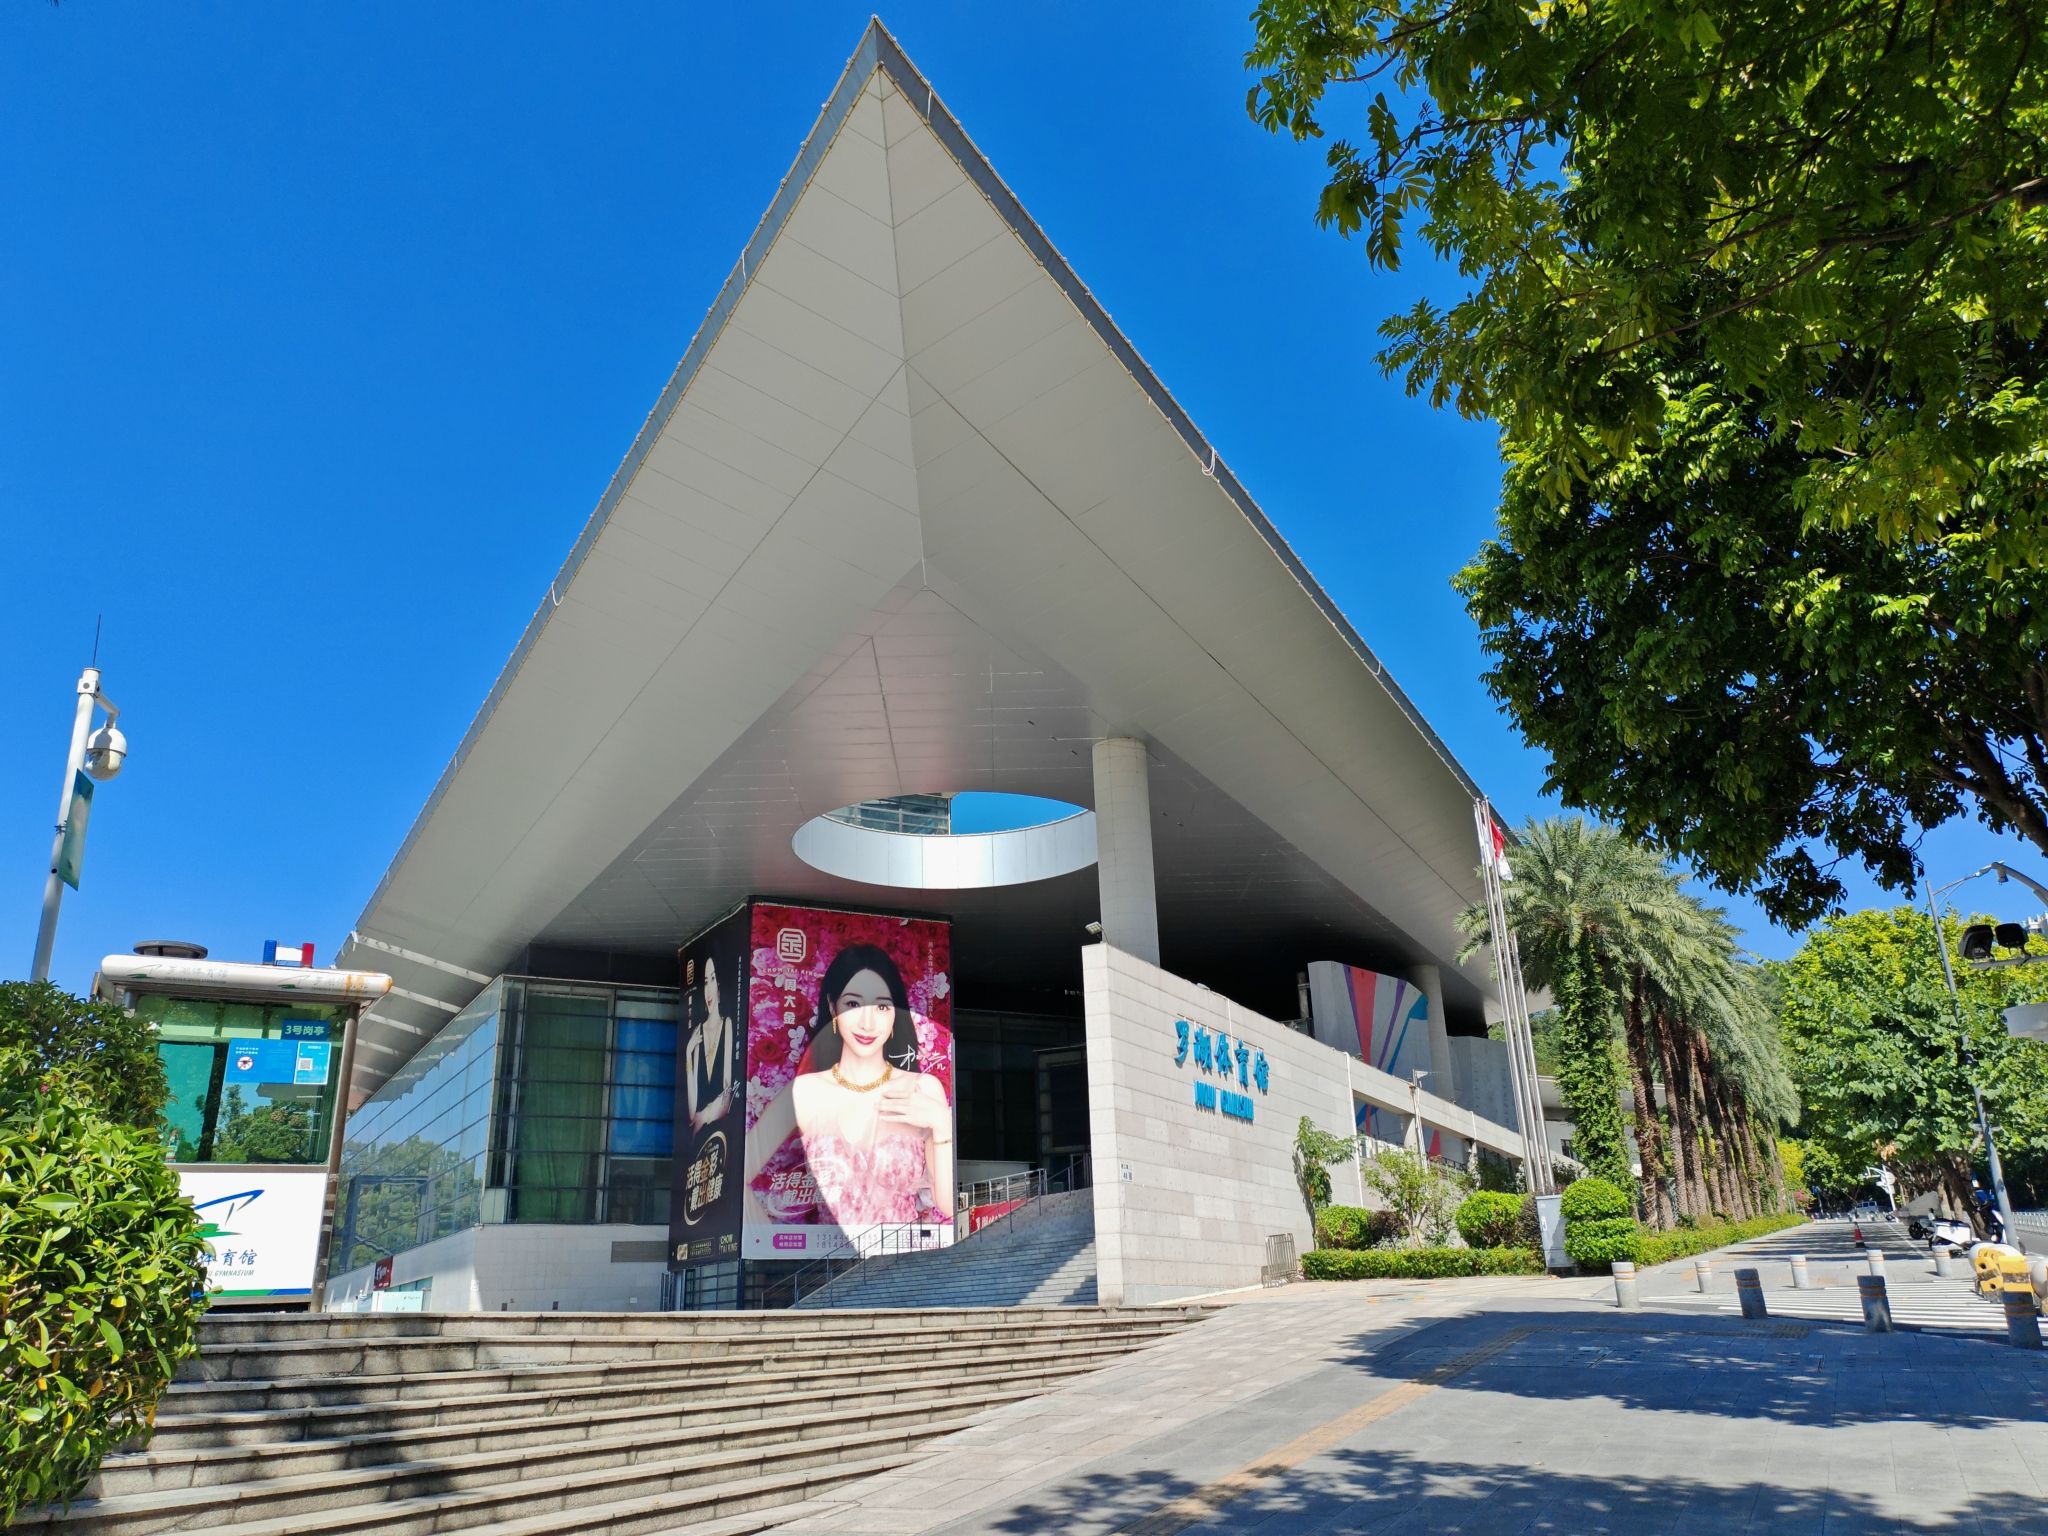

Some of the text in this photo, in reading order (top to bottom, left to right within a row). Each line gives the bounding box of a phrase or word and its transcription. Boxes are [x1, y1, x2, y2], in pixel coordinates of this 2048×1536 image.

[783, 978, 797, 1025] 周大金
[284, 1025, 325, 1036] 3号岗亭
[686, 1150, 719, 1190] 活得金彩
[197, 1248, 258, 1266] 体育馆
[214, 1269, 256, 1278] GYMNASIUM
